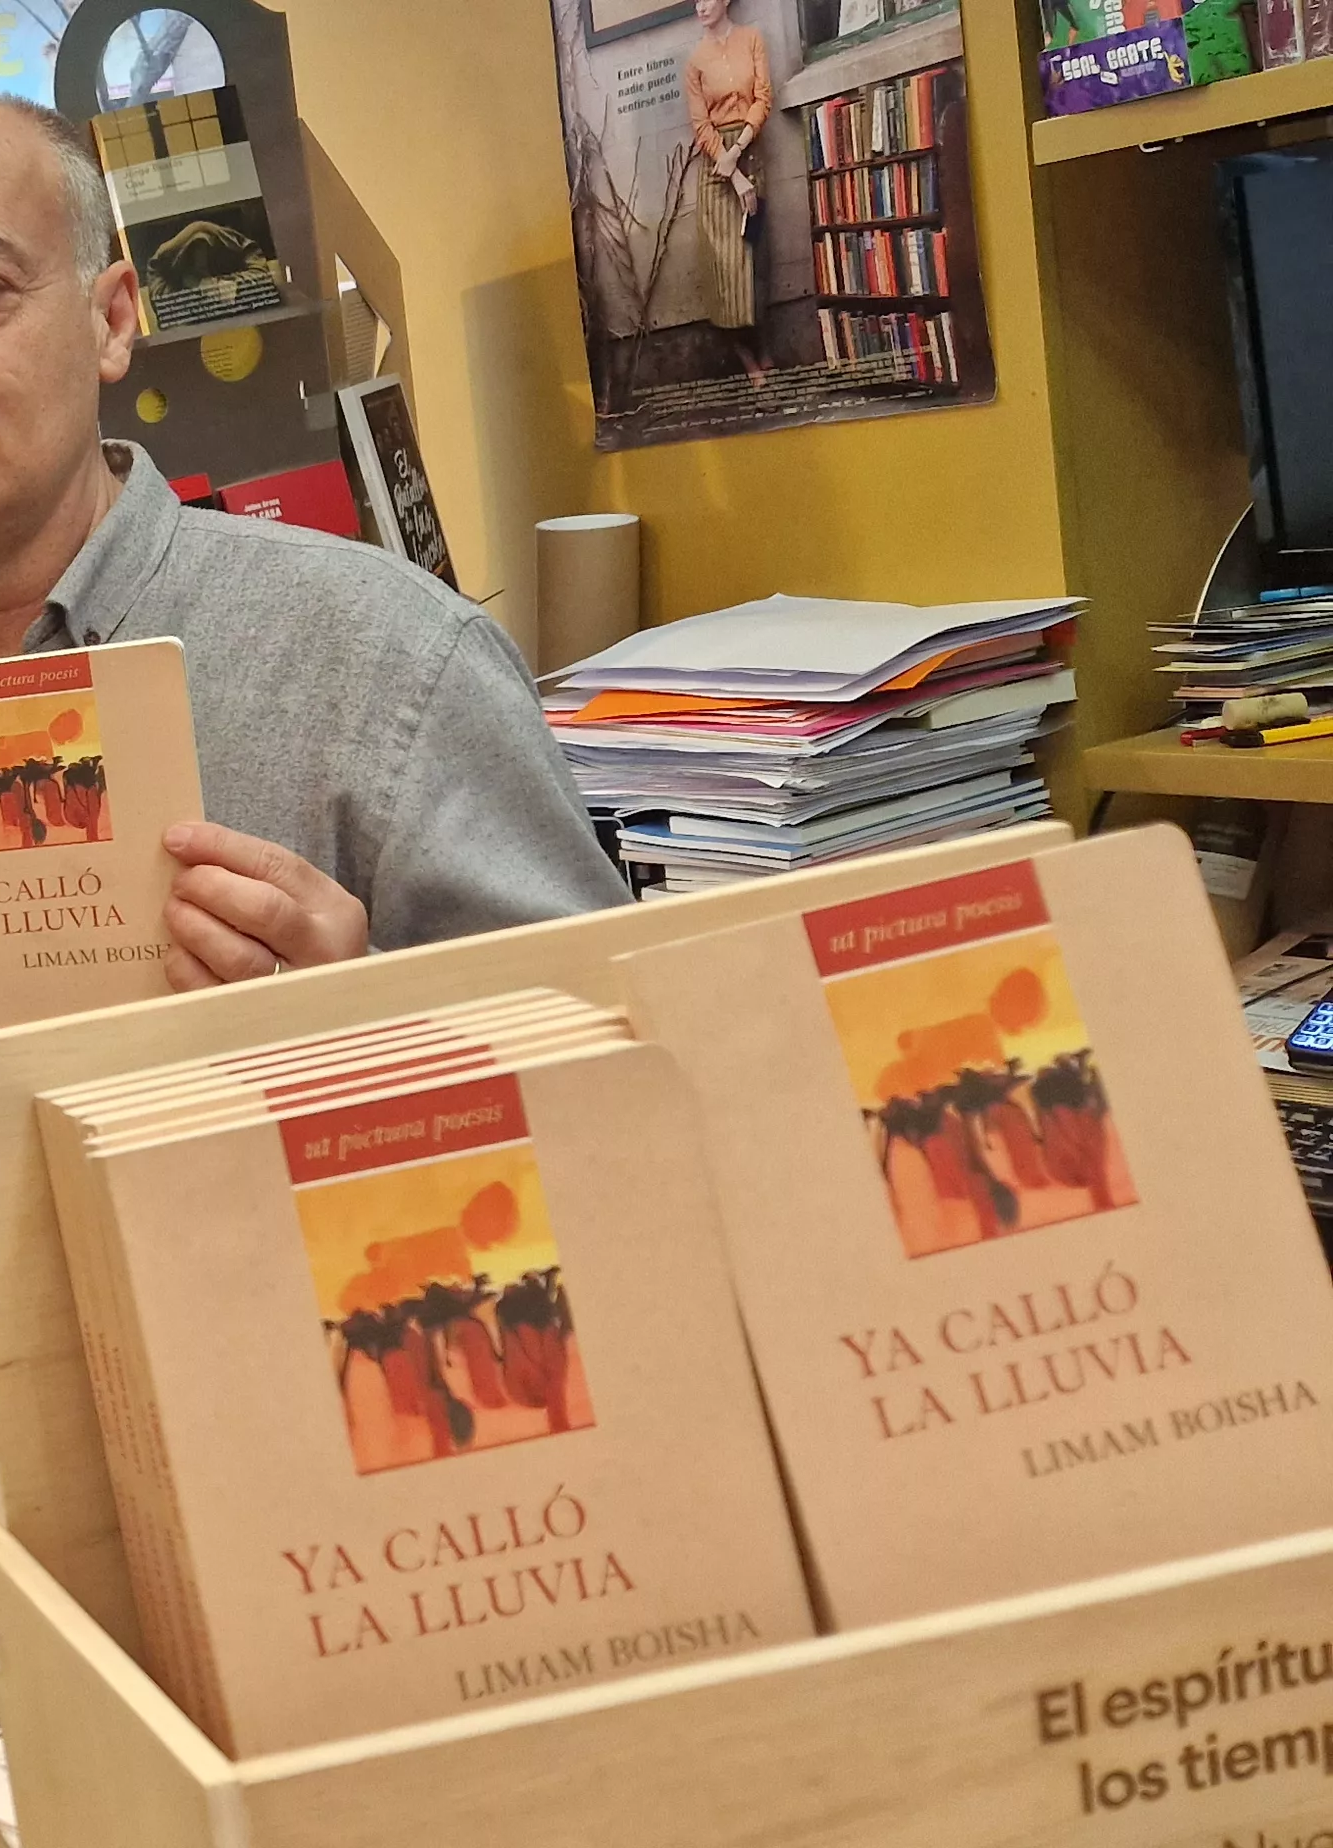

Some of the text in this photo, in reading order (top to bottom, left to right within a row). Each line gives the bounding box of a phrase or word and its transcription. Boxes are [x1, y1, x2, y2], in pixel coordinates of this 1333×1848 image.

[617, 56, 675, 81] Entre libros
[617, 88, 681, 115] sentirse solo
[618, 72, 677, 98] nadie puede
[39, 665, 79, 688] poesis
[1, 904, 127, 936] LLUVIA
[23, 947, 99, 970] LIMAM
[830, 886, 1024, 954] ut pictura poesis
[304, 1098, 505, 1162] ut pictura poesis
[839, 1259, 1140, 1380] YA CALLÓ
[870, 1324, 1193, 1440] LA LLUVIA
[1020, 1378, 1321, 1479] LIMAM BOISHA
[280, 1482, 588, 1596] YA CALLÓ
[309, 1551, 638, 1659] LA LLUVIA
[455, 1609, 763, 1702] LIMAM BOISHA
[1035, 1639, 1333, 1746] El espíritu
[1079, 1720, 1333, 1815] los tiem
